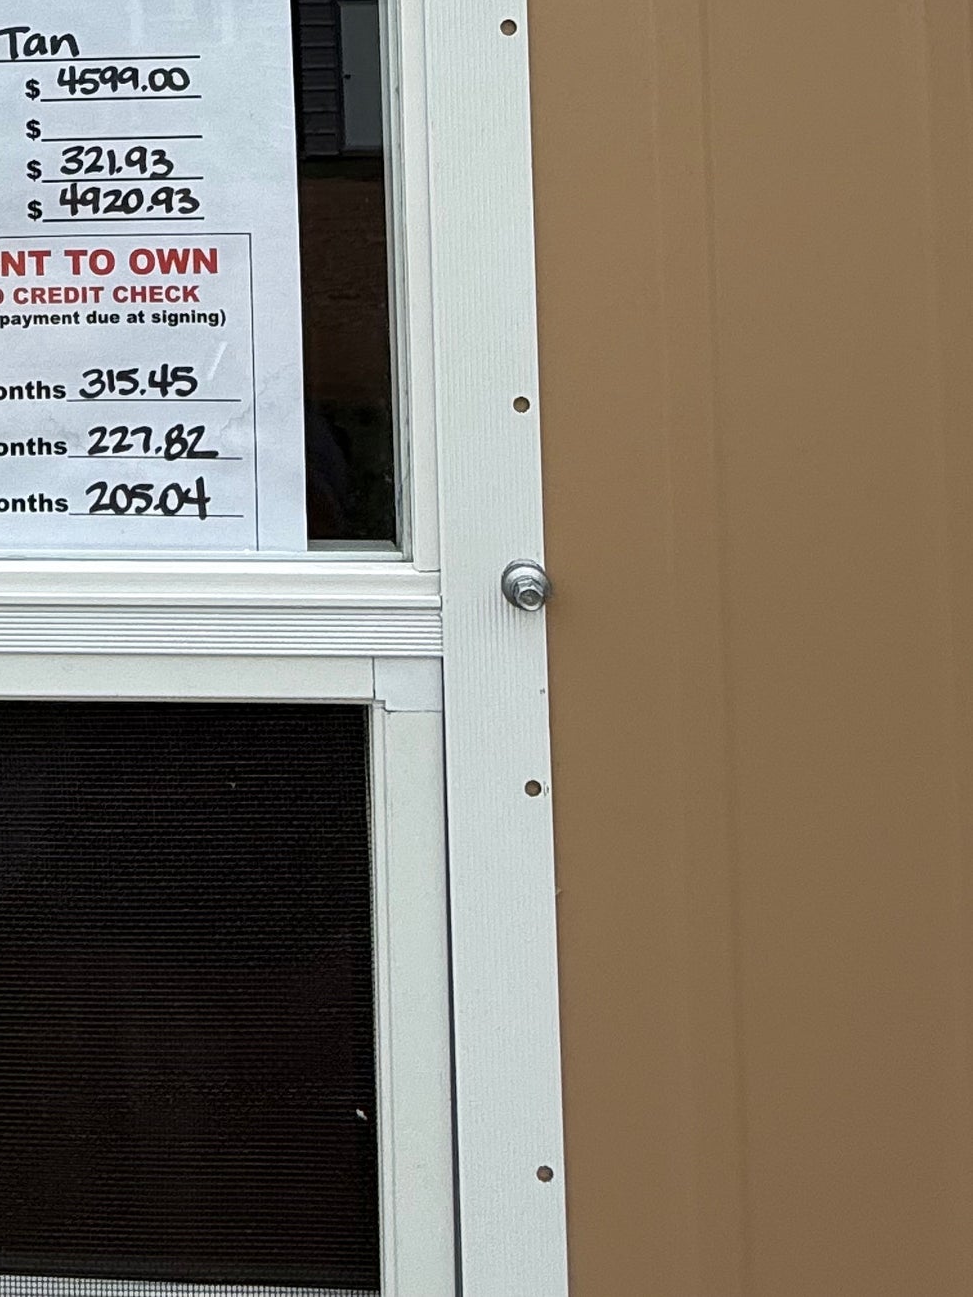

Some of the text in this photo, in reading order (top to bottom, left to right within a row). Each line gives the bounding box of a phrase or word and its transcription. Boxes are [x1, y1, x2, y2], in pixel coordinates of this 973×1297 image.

[25, 79, 41, 100] $
[57, 66, 191, 95] 4599.00
[26, 119, 42, 141] $
[27, 159, 43, 181] $
[60, 146, 174, 179] 321.93
[27, 200, 43, 221] $
[59, 183, 201, 216] 4920.93
[64, 249, 115, 276] TO
[129, 248, 218, 274] OWN
[13, 286, 104, 304] CREDIT
[113, 285, 200, 303] CHECK
[0, 311, 80, 329] payment
[86, 310, 119, 324] due
[126, 310, 145, 324] at
[151, 309, 226, 327] signing)
[79, 364, 198, 399] 315.45
[88, 424, 218, 461] 227.82
[85, 476, 211, 520] 205.04
